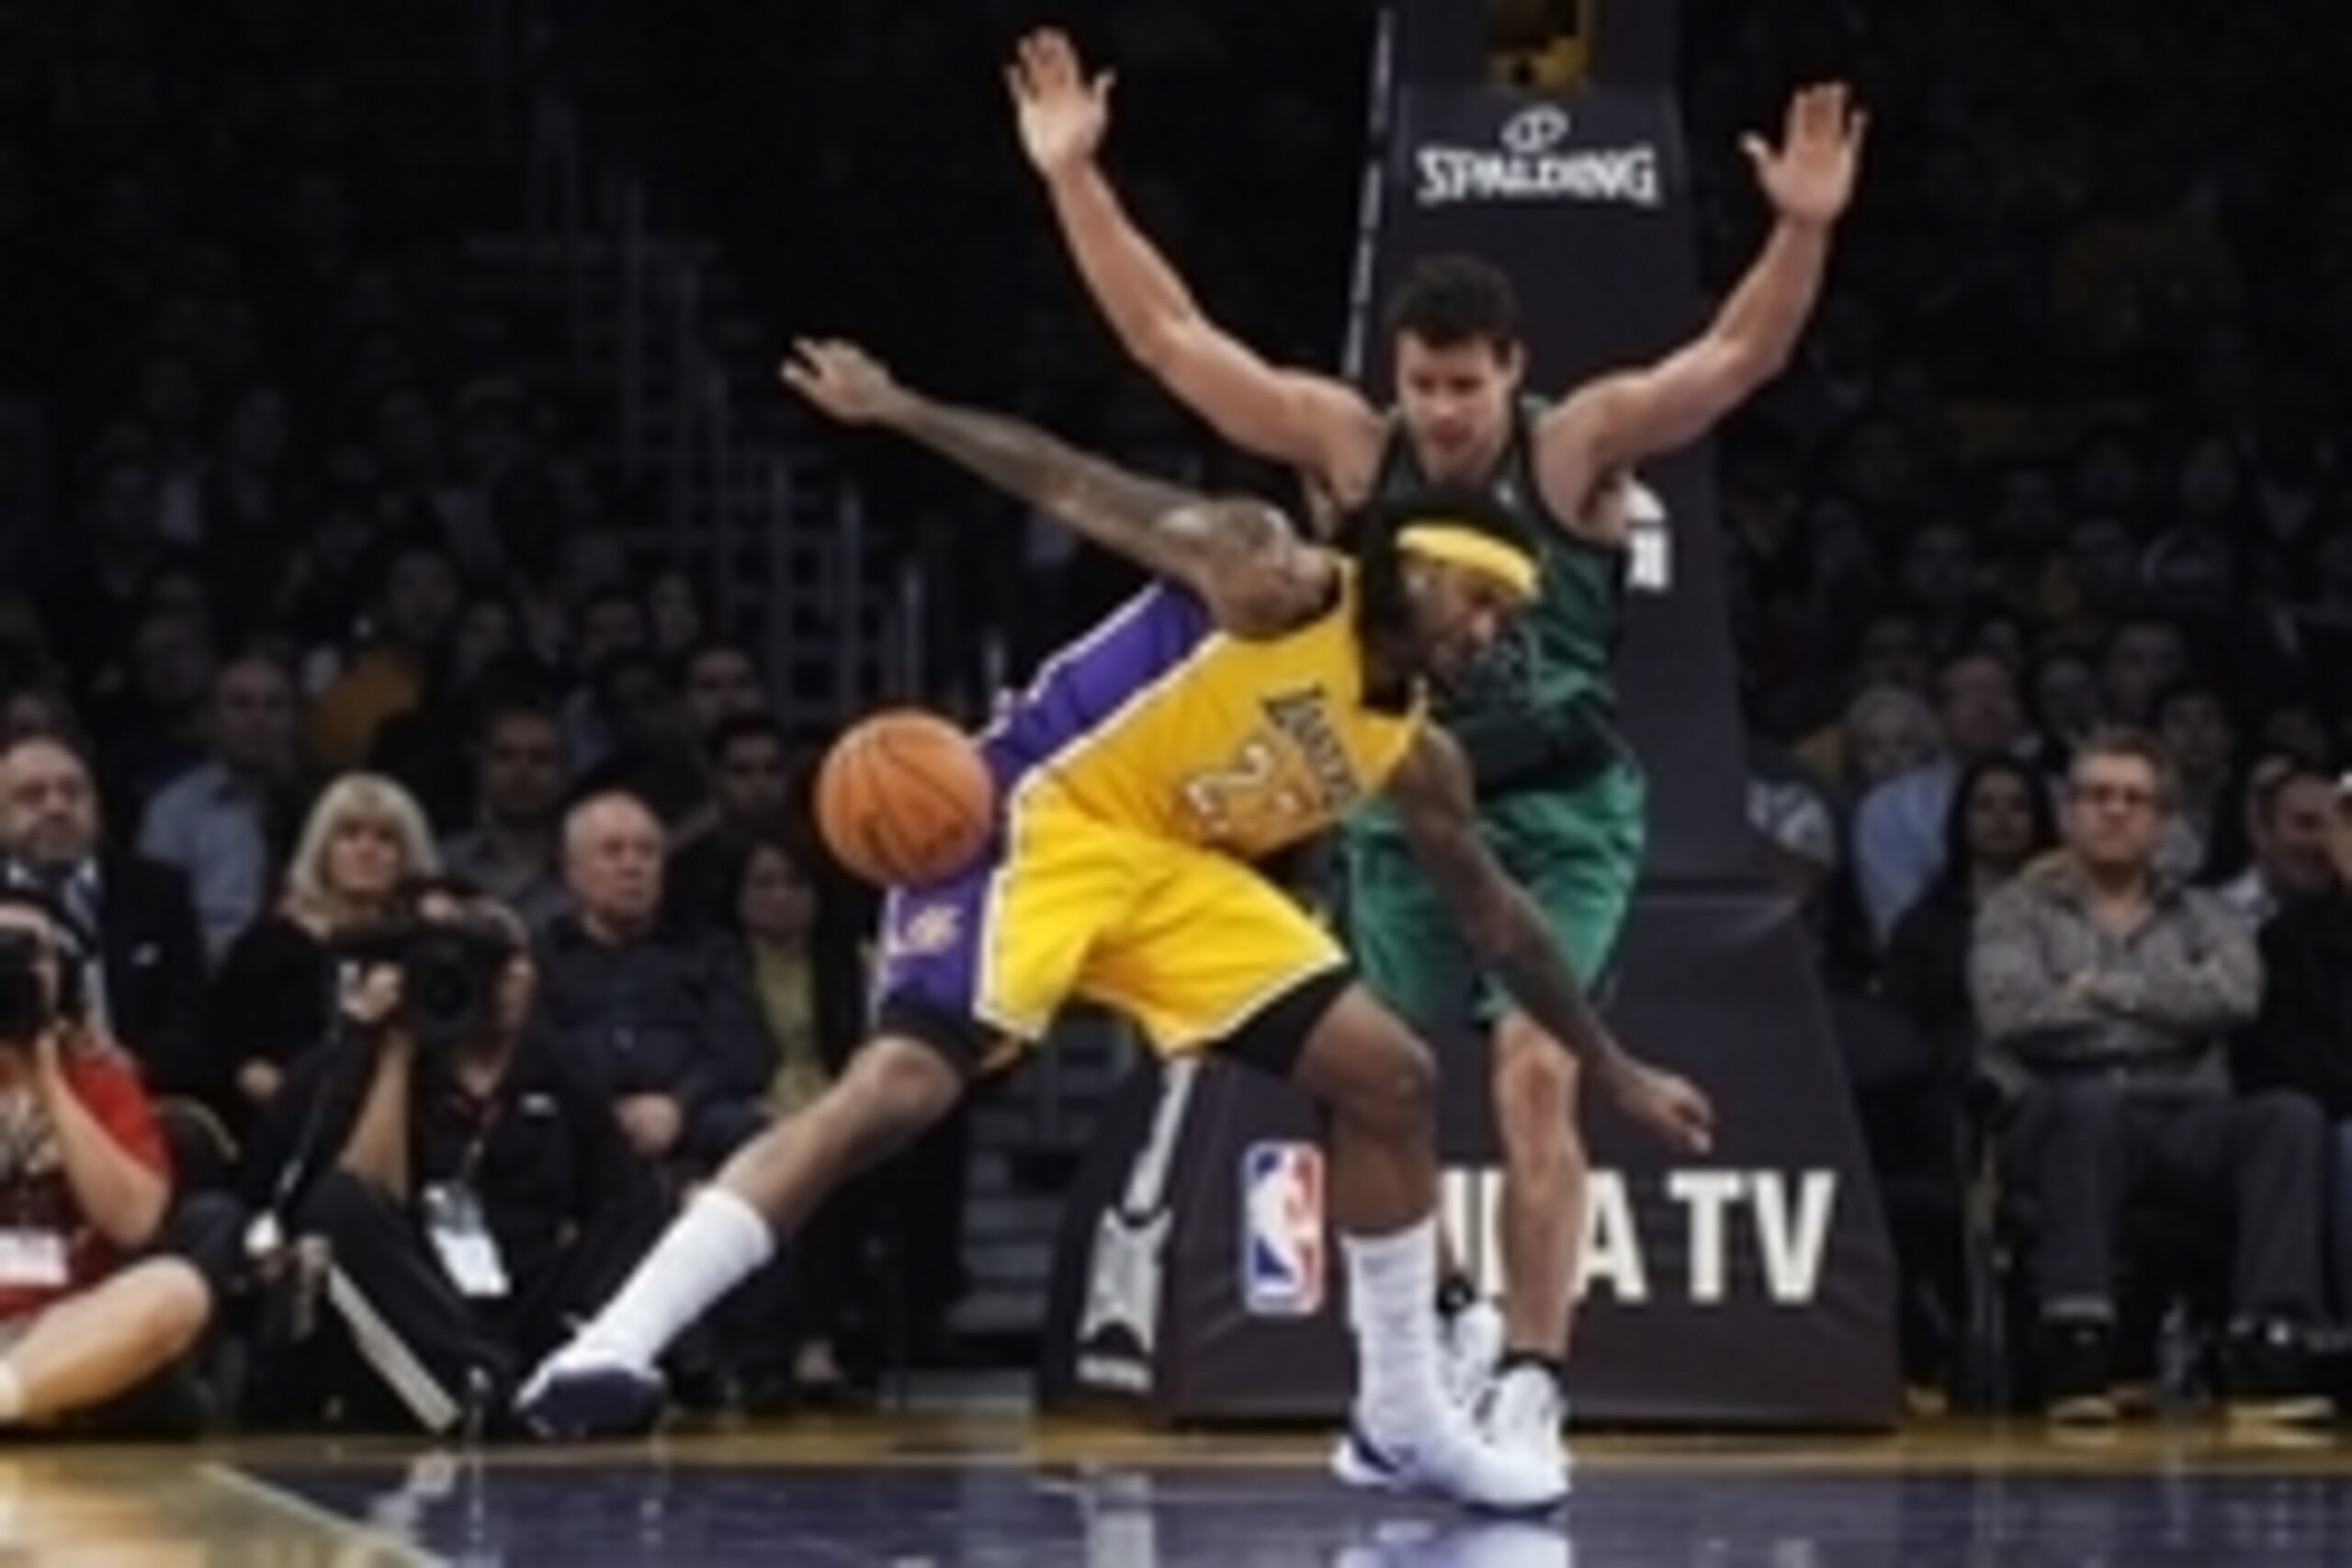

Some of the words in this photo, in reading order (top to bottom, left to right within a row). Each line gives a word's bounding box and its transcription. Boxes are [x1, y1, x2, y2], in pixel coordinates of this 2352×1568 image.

[1414, 143, 1659, 204] SPALDING
[1441, 1169, 1646, 1303] NA
[1668, 1169, 1836, 1303] TV
